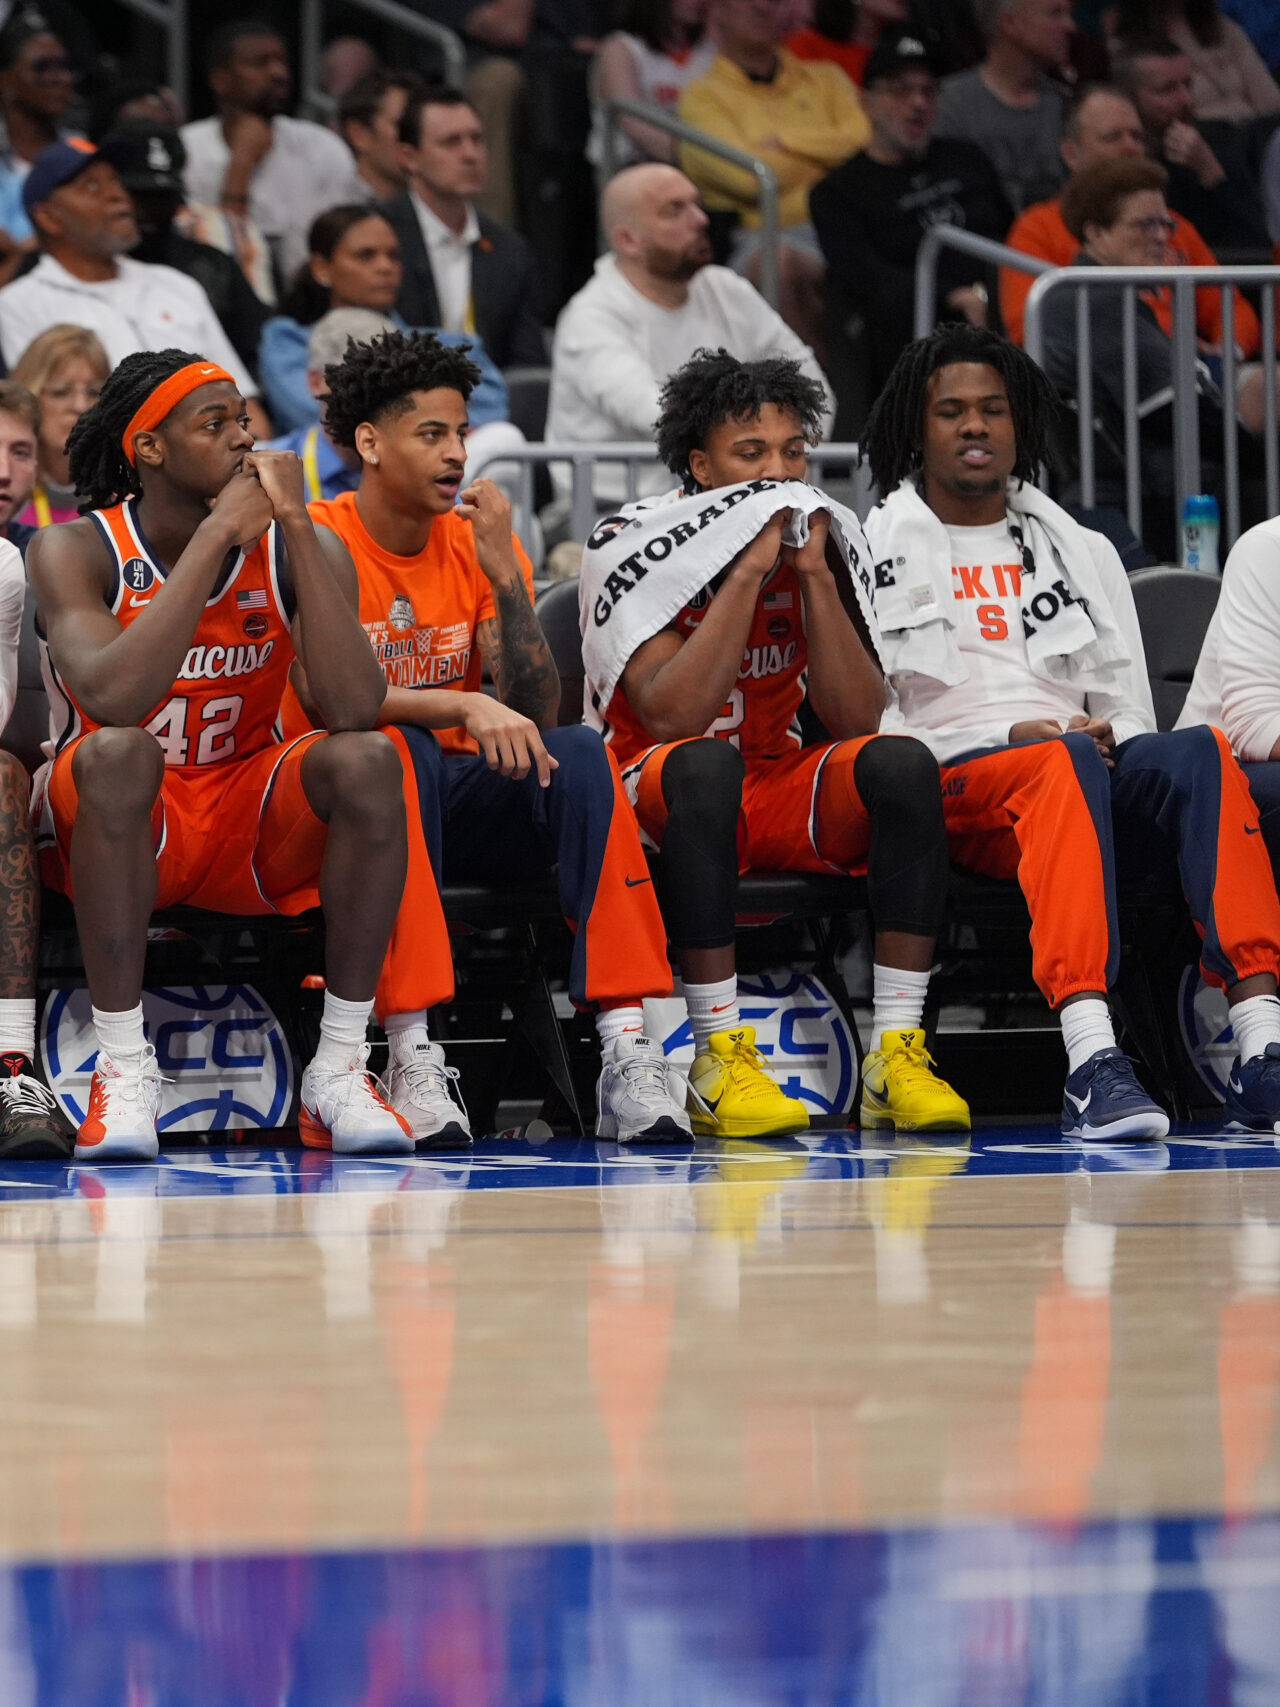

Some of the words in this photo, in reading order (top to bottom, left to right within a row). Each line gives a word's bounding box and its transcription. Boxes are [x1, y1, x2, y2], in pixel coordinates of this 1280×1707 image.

[594, 478, 776, 628] GATORADE
[133, 561, 144, 572] LM
[133, 573, 144, 588] 21
[977, 604, 1009, 641] S
[144, 695, 243, 766] 42
[635, 1038, 650, 1046] NIKE
